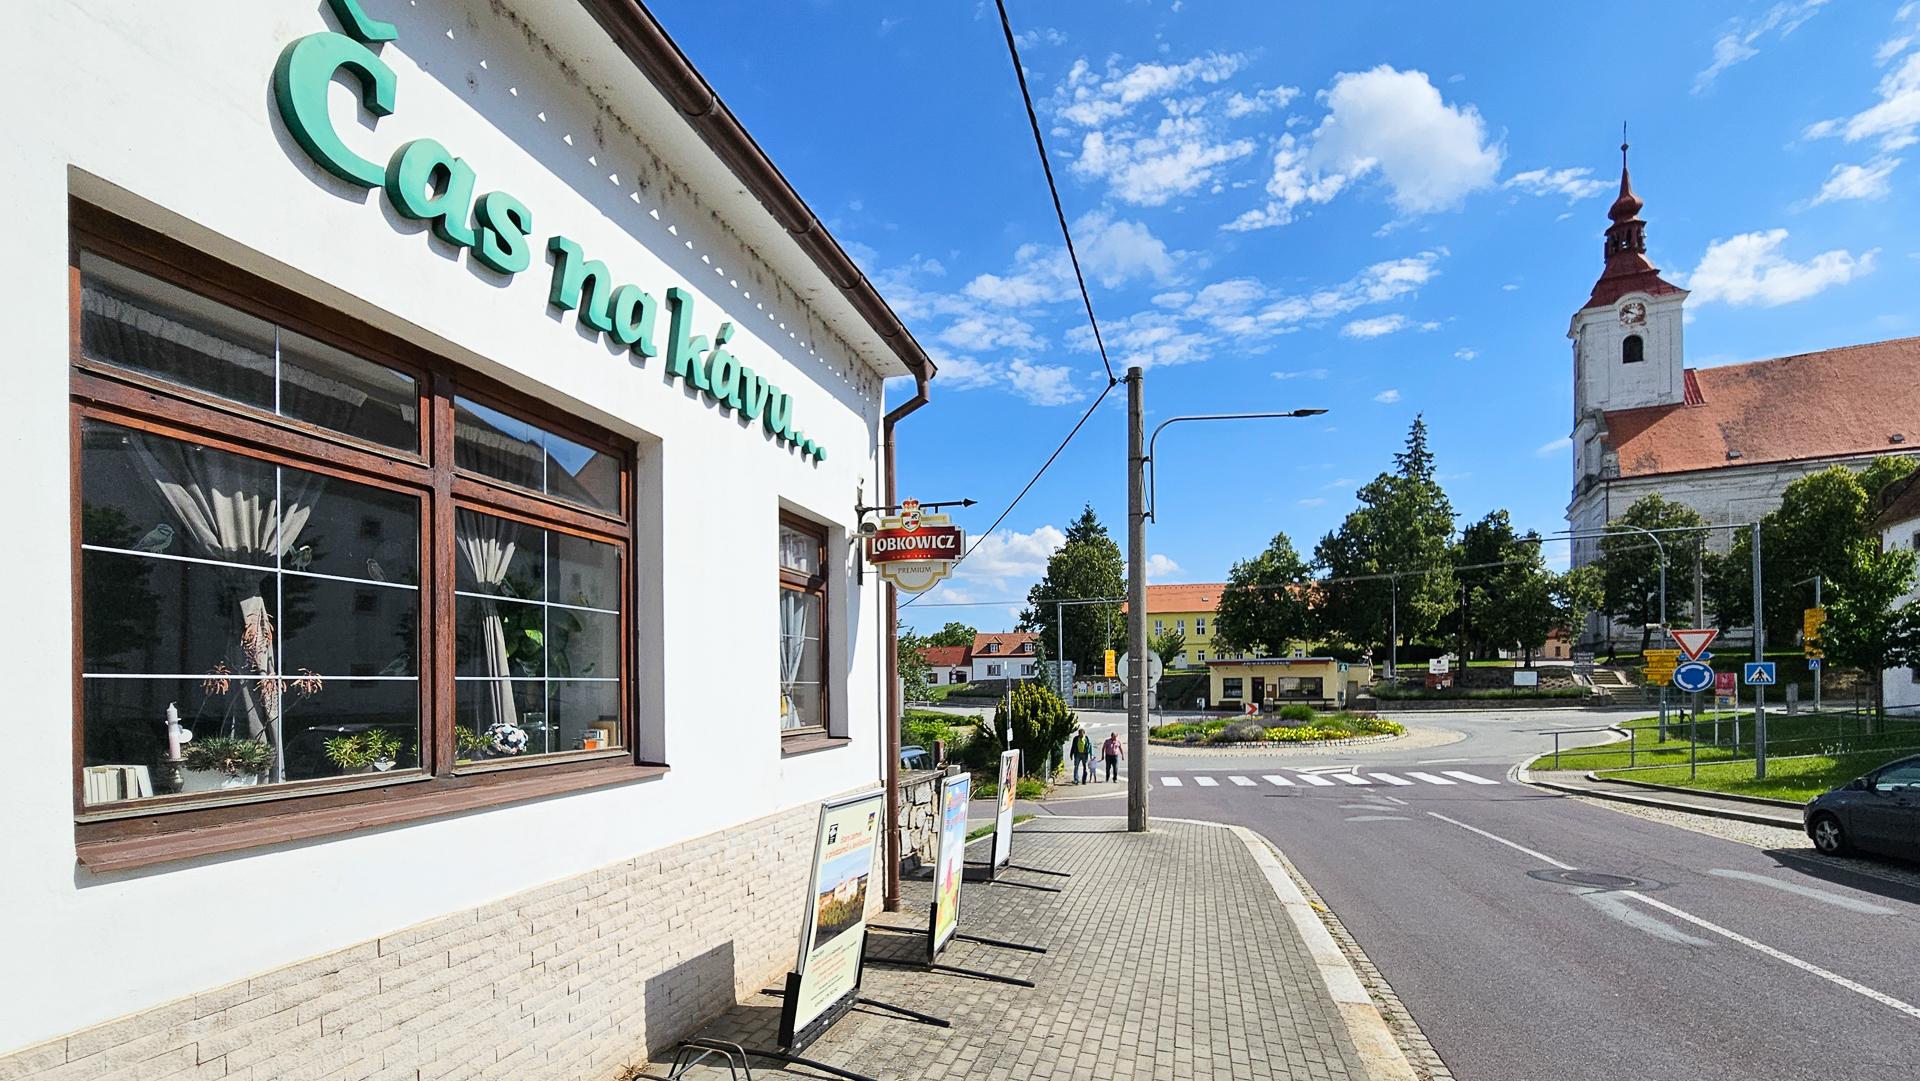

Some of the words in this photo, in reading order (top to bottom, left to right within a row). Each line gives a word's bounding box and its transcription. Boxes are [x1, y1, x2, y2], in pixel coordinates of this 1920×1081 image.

[275, 0, 532, 274] Čas
[548, 236, 657, 358] na
[666, 287, 827, 462] kávu...
[871, 535, 955, 555] LOBKOWICZ
